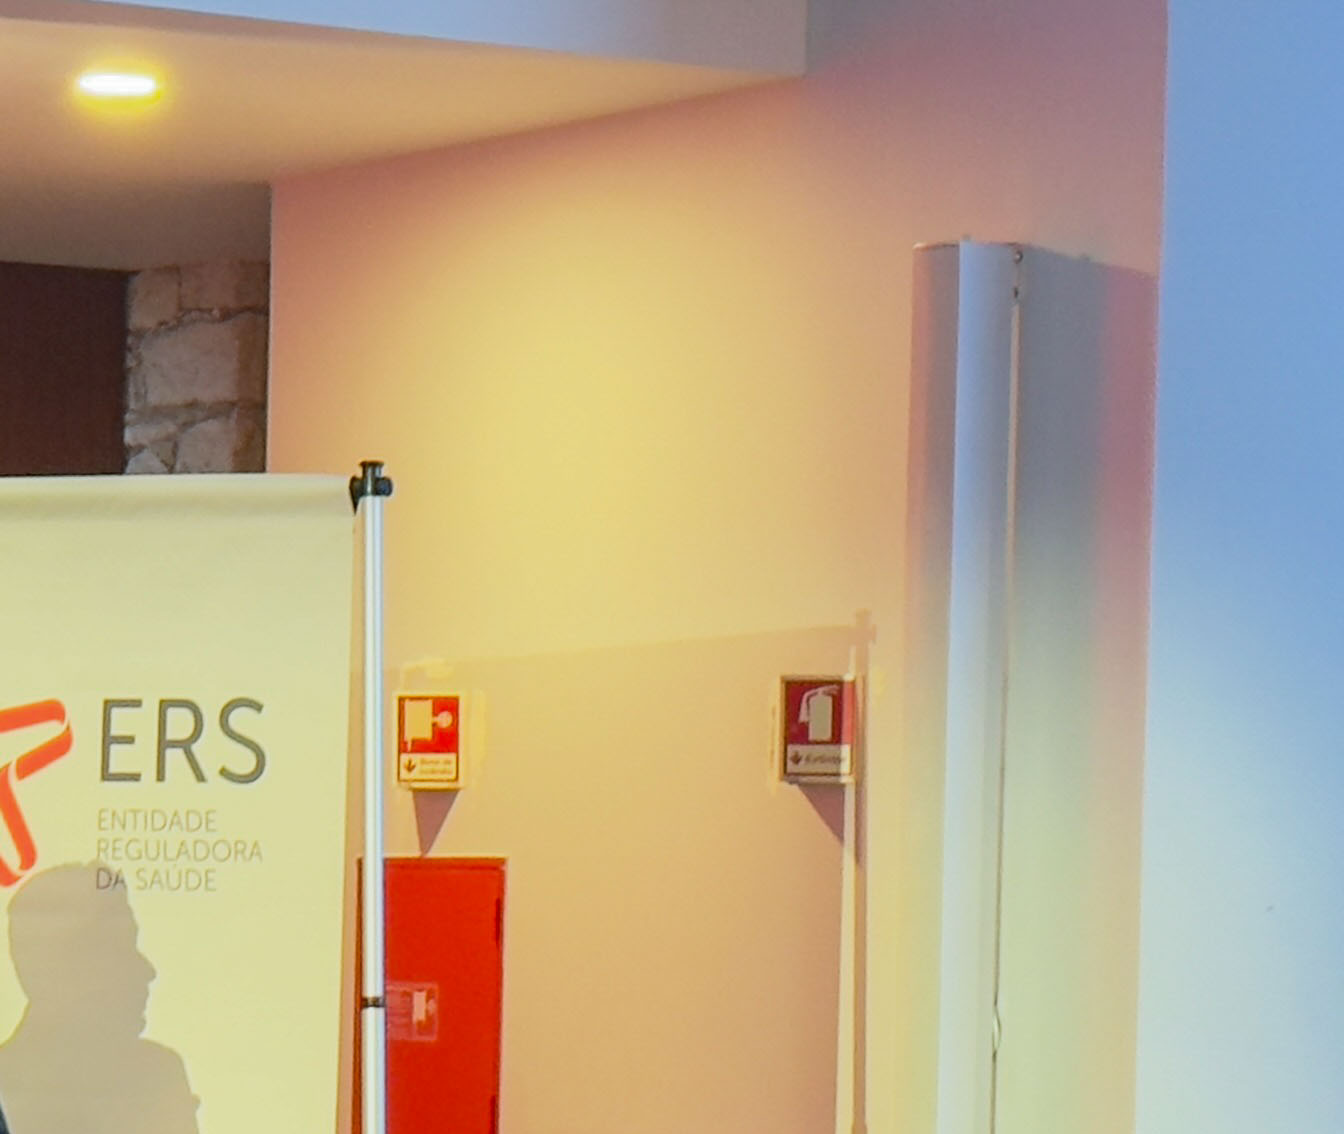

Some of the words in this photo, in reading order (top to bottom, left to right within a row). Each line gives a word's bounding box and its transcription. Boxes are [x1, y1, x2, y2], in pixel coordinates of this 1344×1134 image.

[100, 697, 267, 784] ERS
[97, 808, 217, 833] ENTIDADE
[96, 837, 263, 863] REGULADORA
[95, 866, 127, 890] DA
[135, 863, 217, 892] SAÚDE
